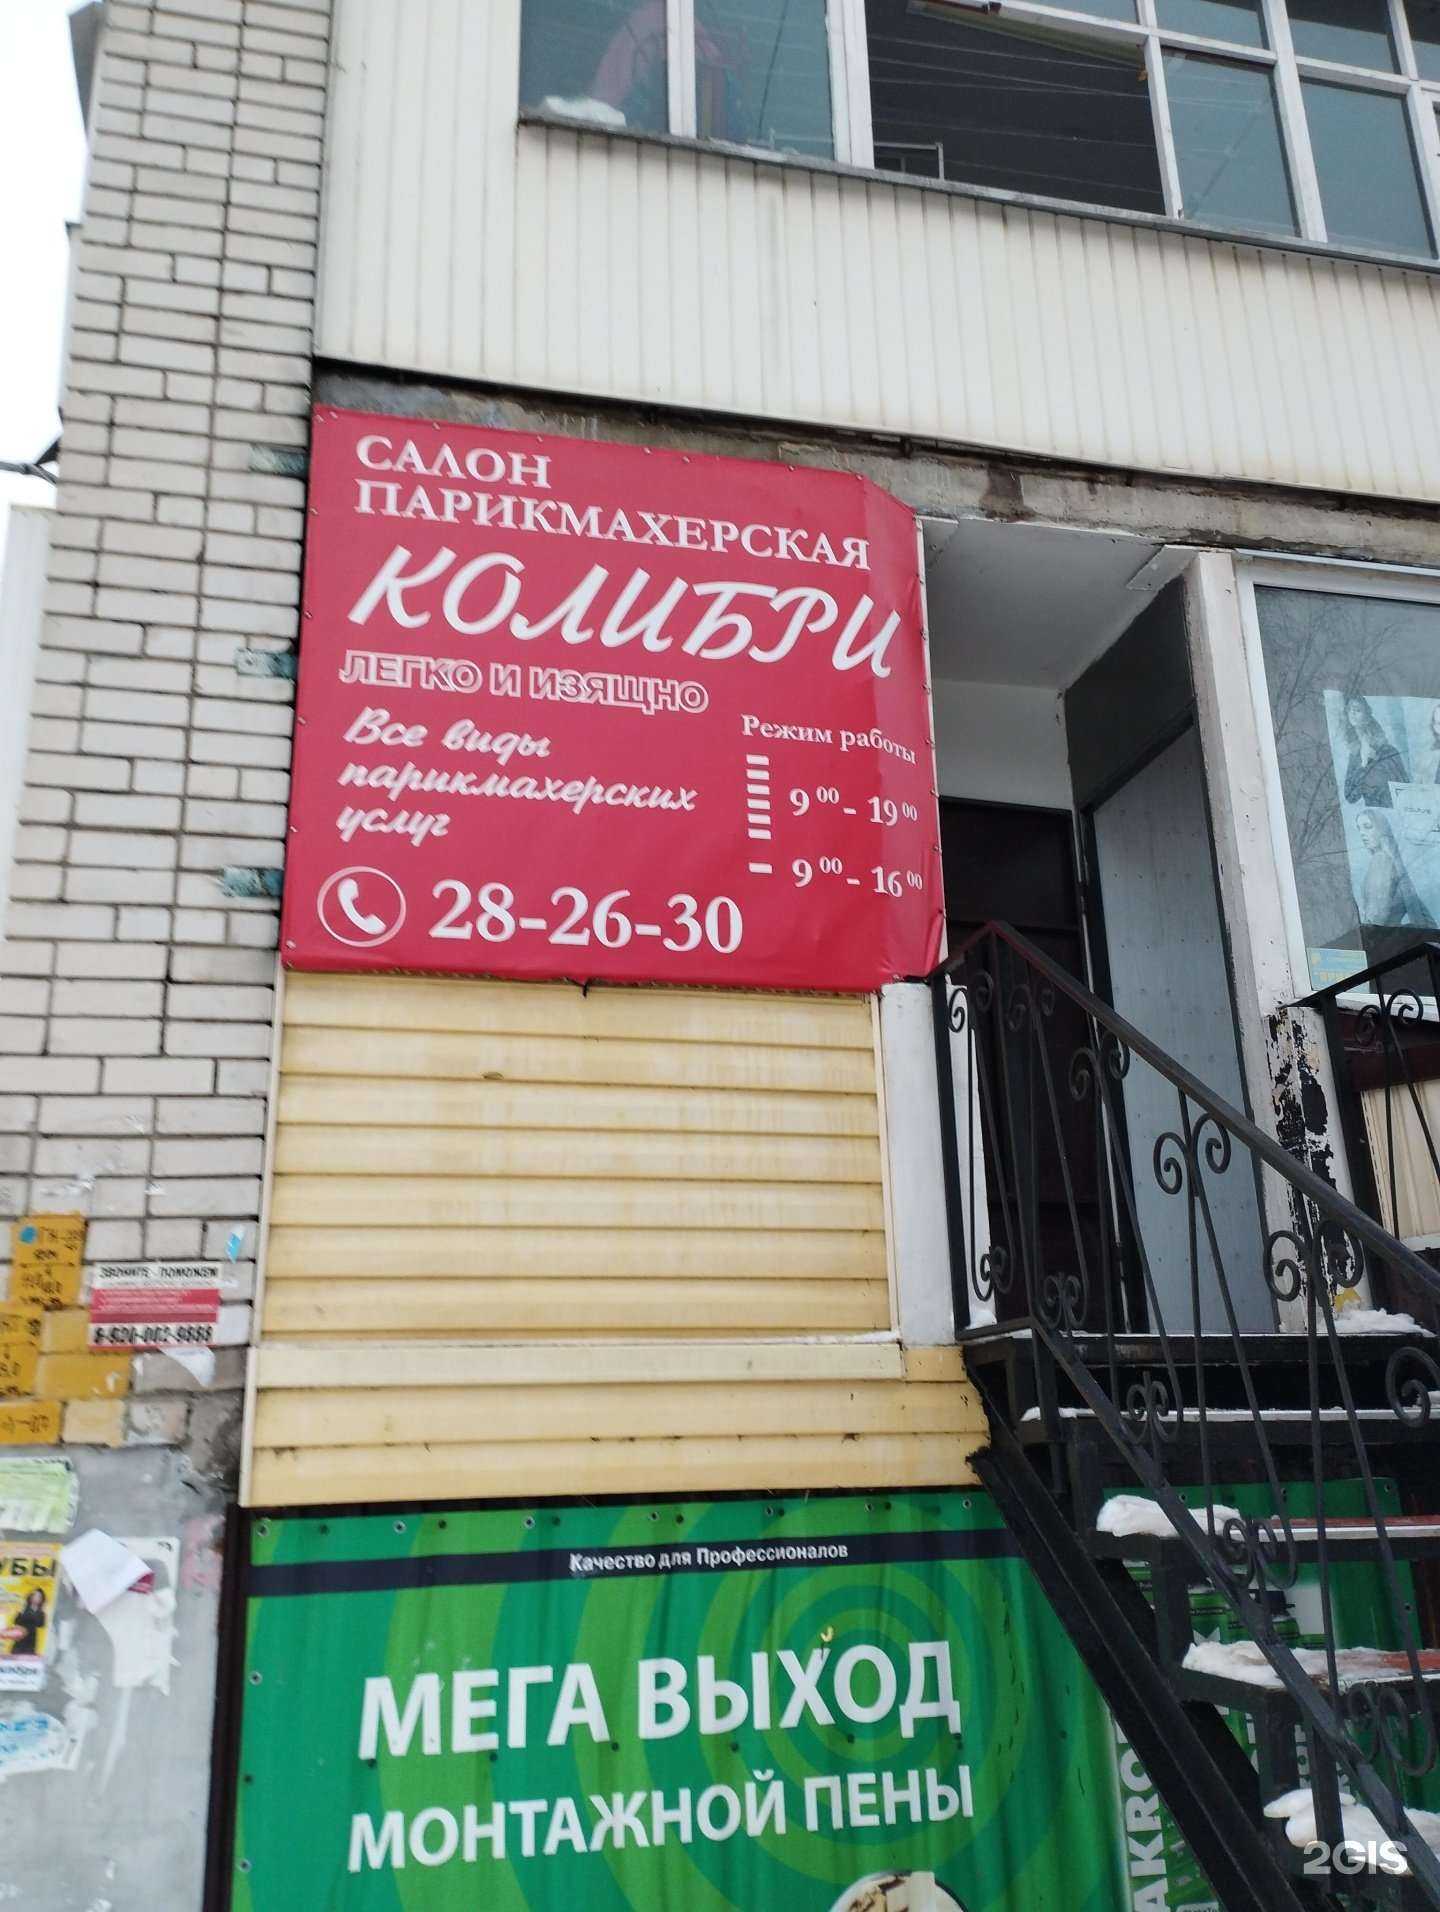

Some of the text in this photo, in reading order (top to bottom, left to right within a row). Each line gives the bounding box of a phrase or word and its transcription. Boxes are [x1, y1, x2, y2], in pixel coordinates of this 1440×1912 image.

[355, 434, 552, 489] САЛОН
[354, 478, 871, 570] ПАРИКМАХЕРСКАЯ
[347, 543, 901, 679] КОЛИБРИ
[339, 649, 709, 715] ЛЕГКО И ИЗЯЩНО
[343, 706, 552, 766] Все виды
[741, 714, 917, 765] Режим работы
[337, 761, 699, 814] парикмахерских
[336, 805, 451, 848] услуг
[428, 878, 744, 954] 28-26-30
[569, 1544, 849, 1572] Качество для Профессионалов
[358, 1641, 962, 1760] МЕГА ВЫХОД
[347, 1765, 974, 1873] МОНТАЖНОЙ ПЕНЫ
